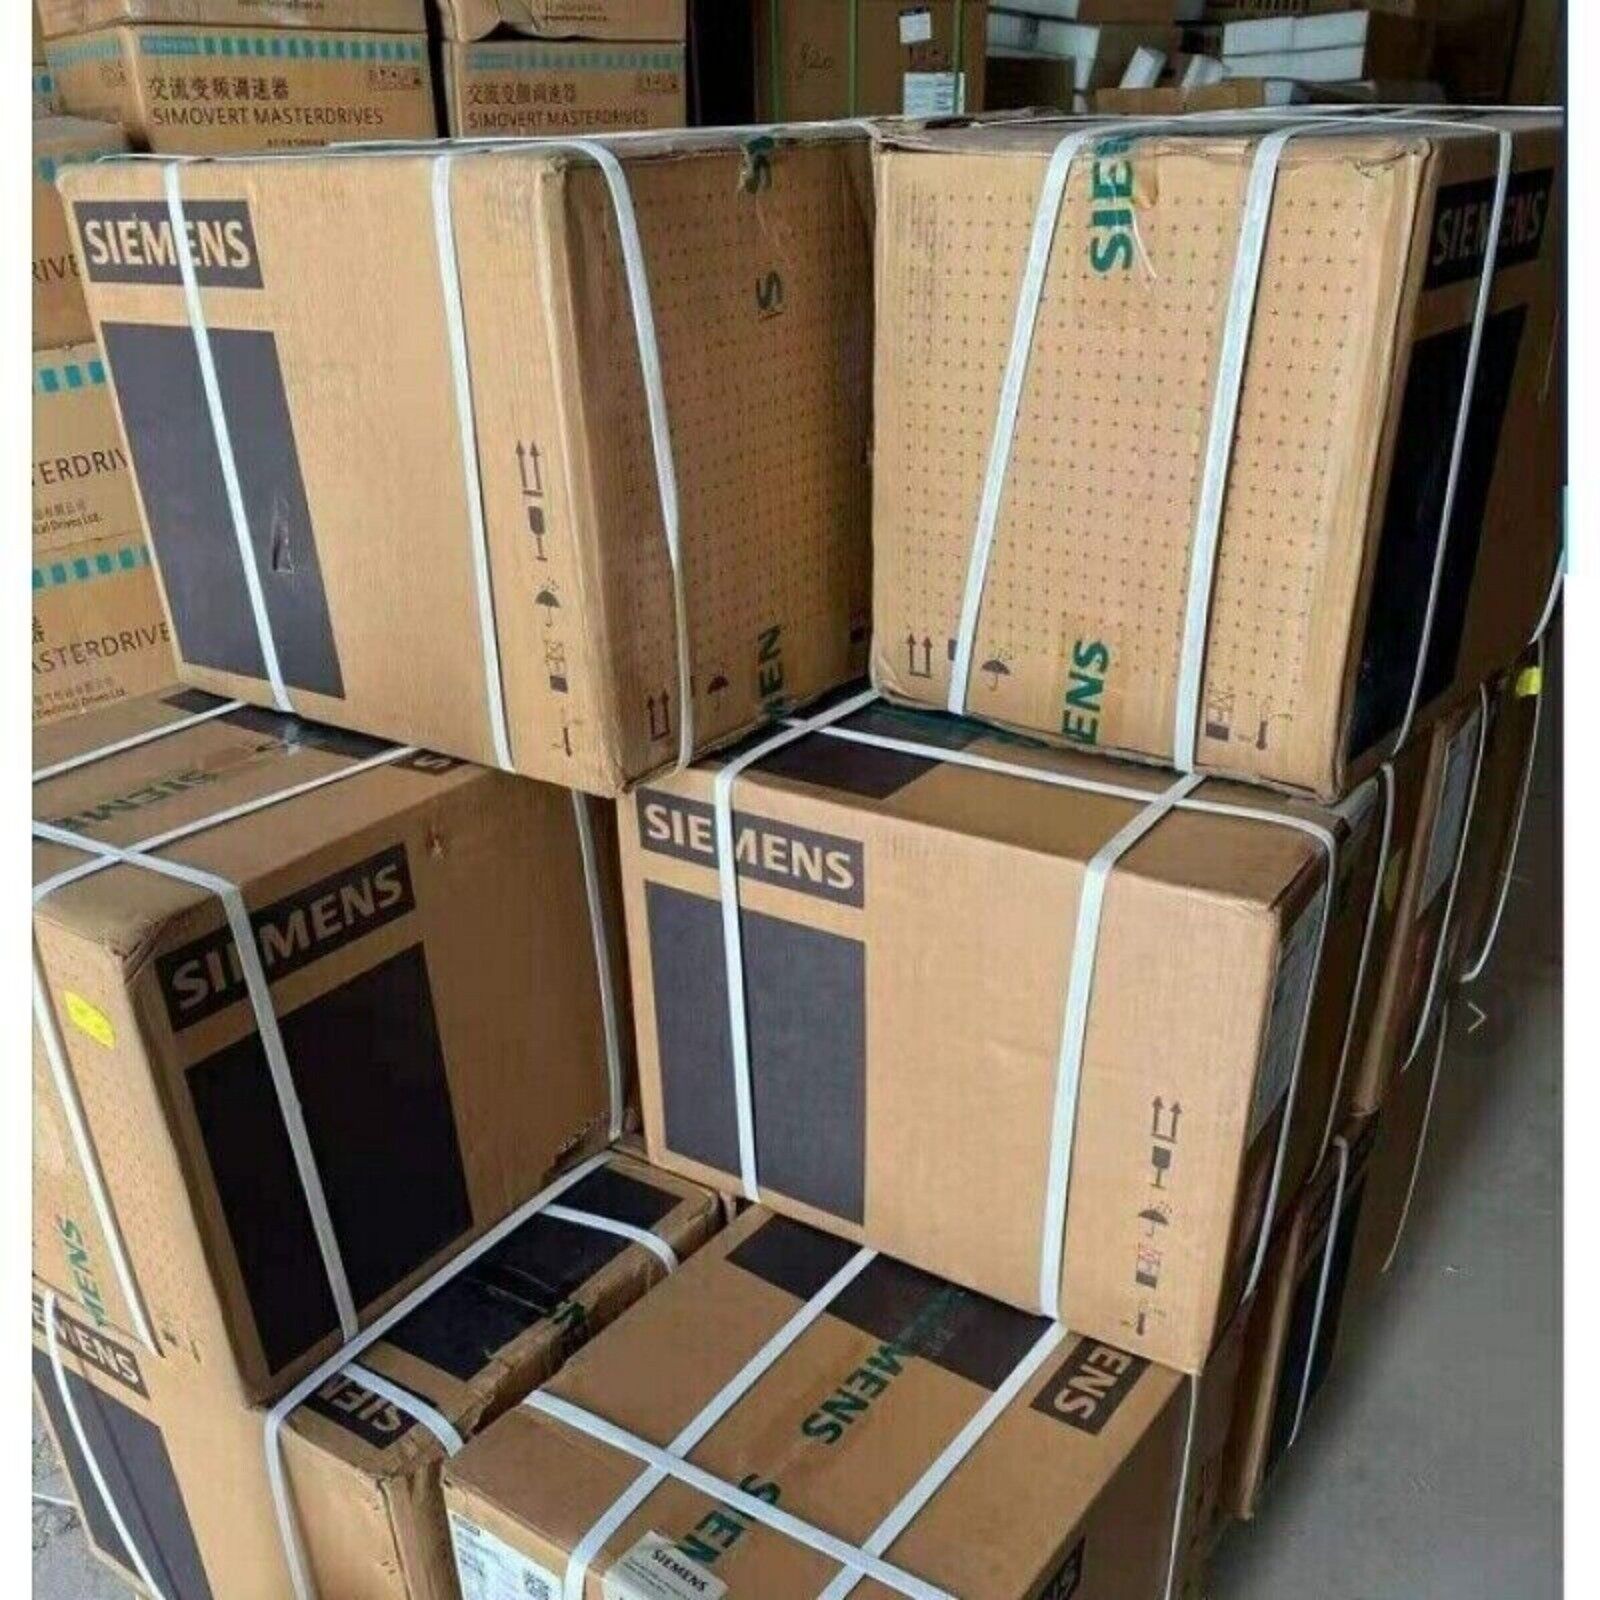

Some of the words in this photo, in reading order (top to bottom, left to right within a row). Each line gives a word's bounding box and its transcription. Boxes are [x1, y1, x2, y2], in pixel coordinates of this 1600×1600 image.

[152, 106, 247, 125] SIMOVERT
[253, 106, 385, 126] MASTERDRIVES
[467, 107, 544, 129] SIMOVERT
[548, 106, 649, 127] MASTERDRIVES
[84, 219, 250, 268] SIEMENS
[651, 1548, 709, 1593] SIEMENS
